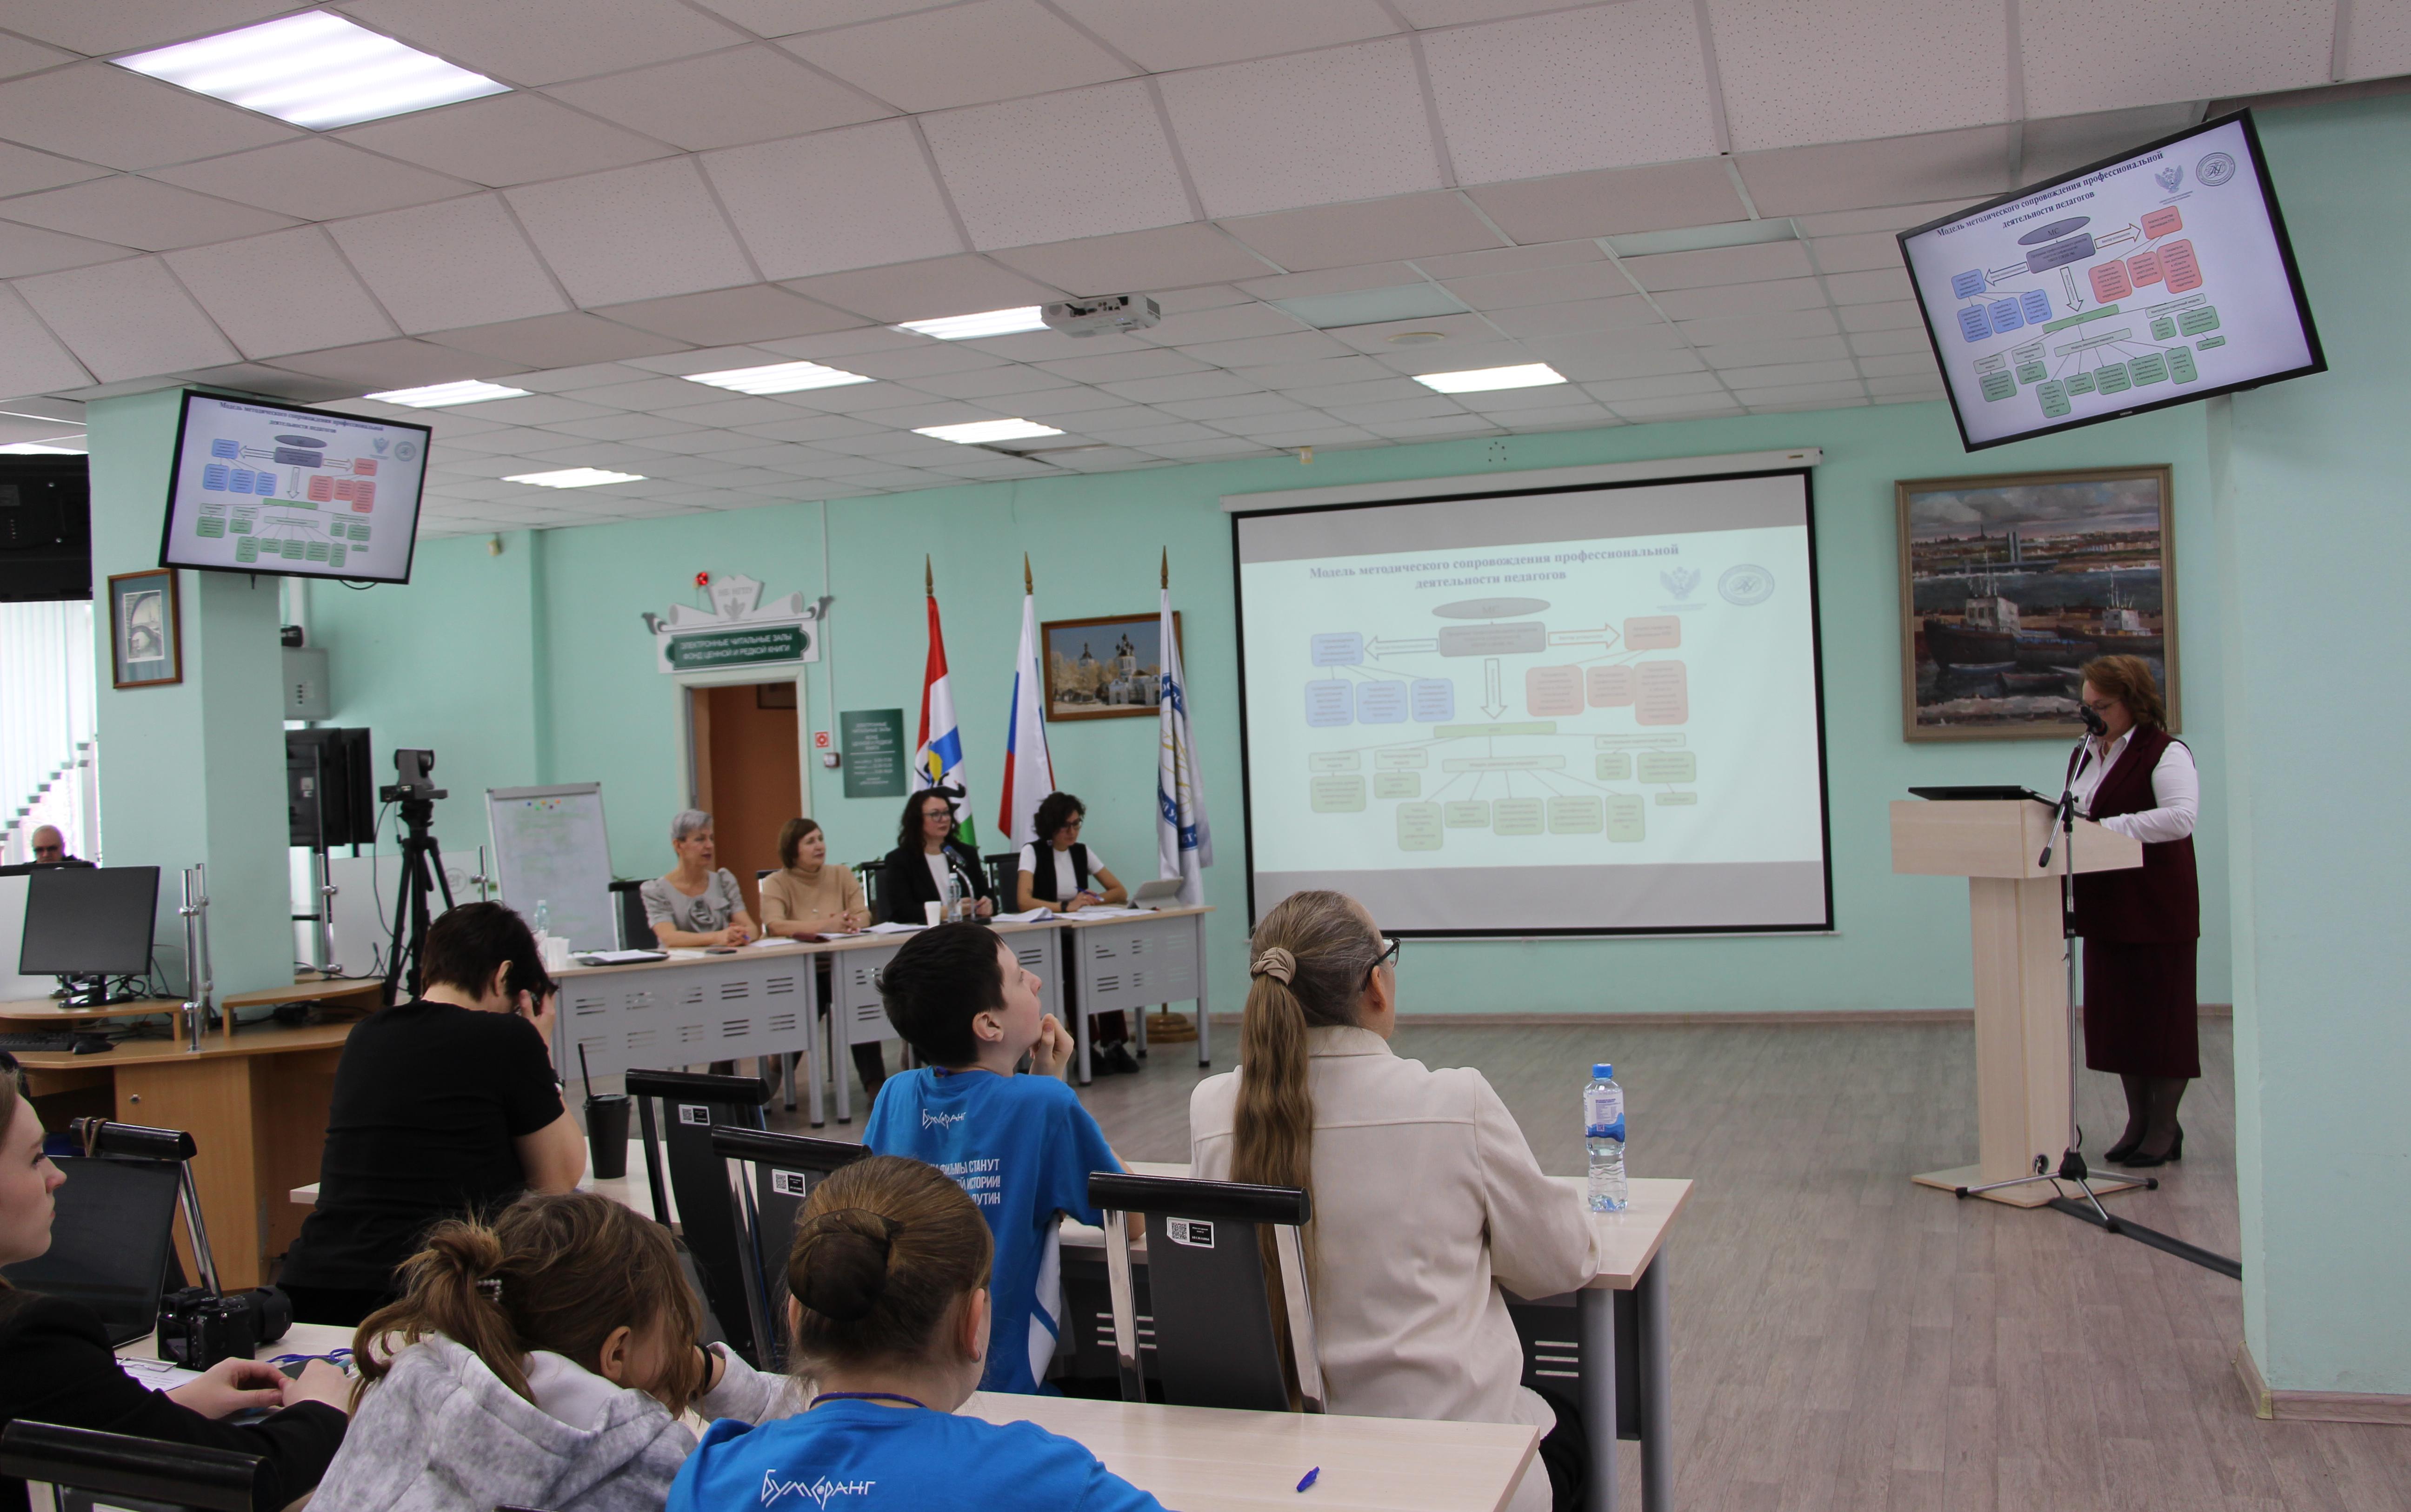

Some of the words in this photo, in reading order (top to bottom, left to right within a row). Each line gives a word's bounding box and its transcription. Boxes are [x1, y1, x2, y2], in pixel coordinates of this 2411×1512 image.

[1937, 222, 1965, 238] Модель
[1966, 204, 2019, 228] методического
[2021, 182, 2081, 211] сопровождения
[2082, 150, 2164, 189] профессиональной
[2002, 206, 2055, 229] деятельности
[2056, 190, 2095, 213] педагогов
[2047, 227, 2060, 238] МС
[1310, 564, 1356, 580] Модель
[1359, 558, 1450, 576] методического
[1453, 552, 1551, 570] сопровождения
[1553, 543, 1679, 564] профессиональной
[1414, 572, 1501, 591] деятельности
[1504, 568, 1567, 586] педагогов
[731, 635, 771, 645] ЧИТАЛЬНЫЕ
[772, 633, 793, 642] ЗАЛЫ
[704, 648, 732, 659] ЦЕННОЙ
[739, 645, 767, 656] РЕДКОЙ
[767, 644, 791, 652] КНИГИ
[940, 1161, 968, 1175] ФИЛЬМЫ
[969, 1158, 1000, 1173] СТАНУТ
[967, 1175, 1001, 1190] ИСТОРИИ!
